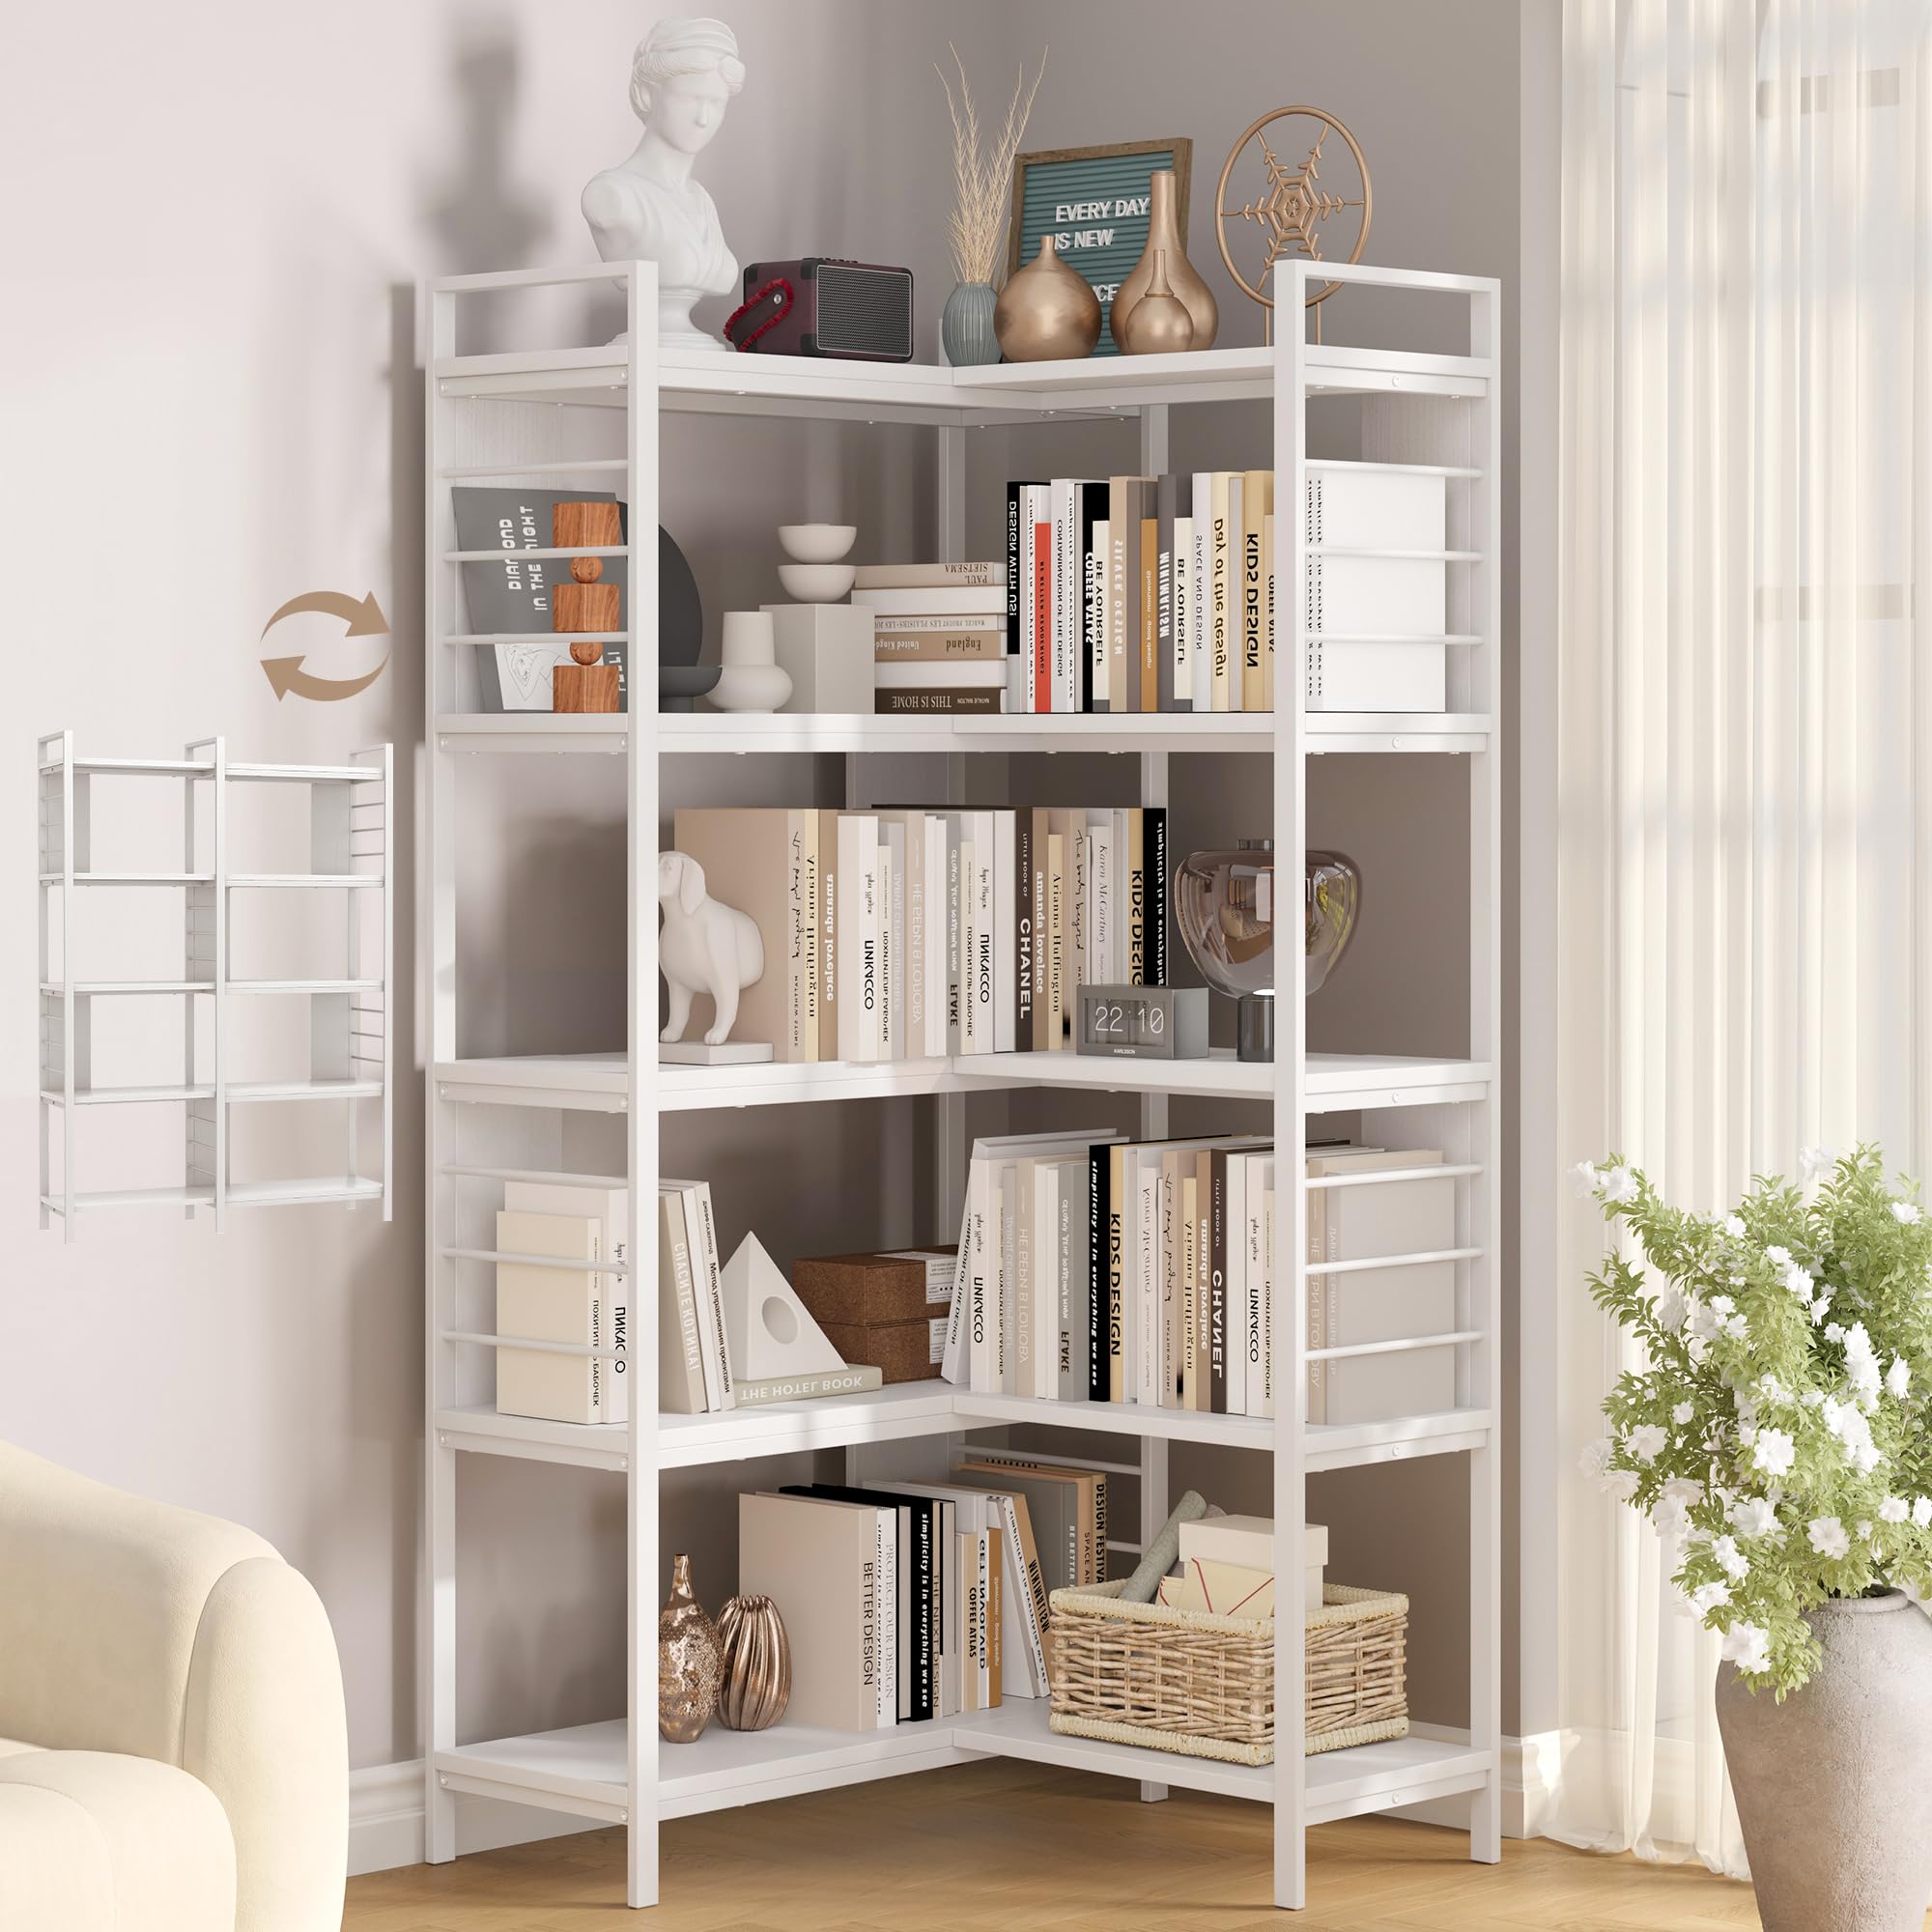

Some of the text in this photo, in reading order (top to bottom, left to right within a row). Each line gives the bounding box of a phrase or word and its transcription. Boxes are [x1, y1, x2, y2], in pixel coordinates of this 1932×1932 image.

[1056, 197, 1150, 222] EVERY DAY
[1055, 228, 1115, 250] IS NEW
[528, 564, 543, 589] THE
[945, 564, 988, 573] SIETSEMA
[897, 640, 919, 649] United
[946, 638, 980, 651] England
[892, 696, 919, 708] HOME
[921, 696, 928, 708] IS
[932, 696, 952, 708] THIS
[1099, 845, 1108, 877] Karen
[1023, 887, 1027, 896] OF
[1097, 882, 1108, 943] McCartney
[1036, 871, 1044, 993] amanda lovelace
[980, 934, 989, 1003] ПИКАССО
[1020, 918, 1031, 1019] CHANEL
[1052, 935, 1061, 1012] Huffington
[1095, 1007, 1163, 1034] 22 10
[1092, 1233, 1098, 1243] is
[1092, 1249, 1098, 1261] in
[709, 1263, 719, 1291] Метод
[1111, 1213, 1121, 1355] KIDS DESIGN
[674, 1243, 699, 1370] СПАСИТЕ КОТИКА!
[711, 1291, 725, 1345] управления
[1092, 1342, 1098, 1358] we
[720, 1347, 730, 1393] проектами
[1069, 1525, 1075, 1539] BE
[1096, 1484, 1105, 1583] DESIGN FESTIVA
[921, 1576, 928, 1584] is
[921, 1589, 928, 1599] in
[864, 1563, 873, 1686] BETTER DESIGN
[921, 1670, 928, 1684] we
